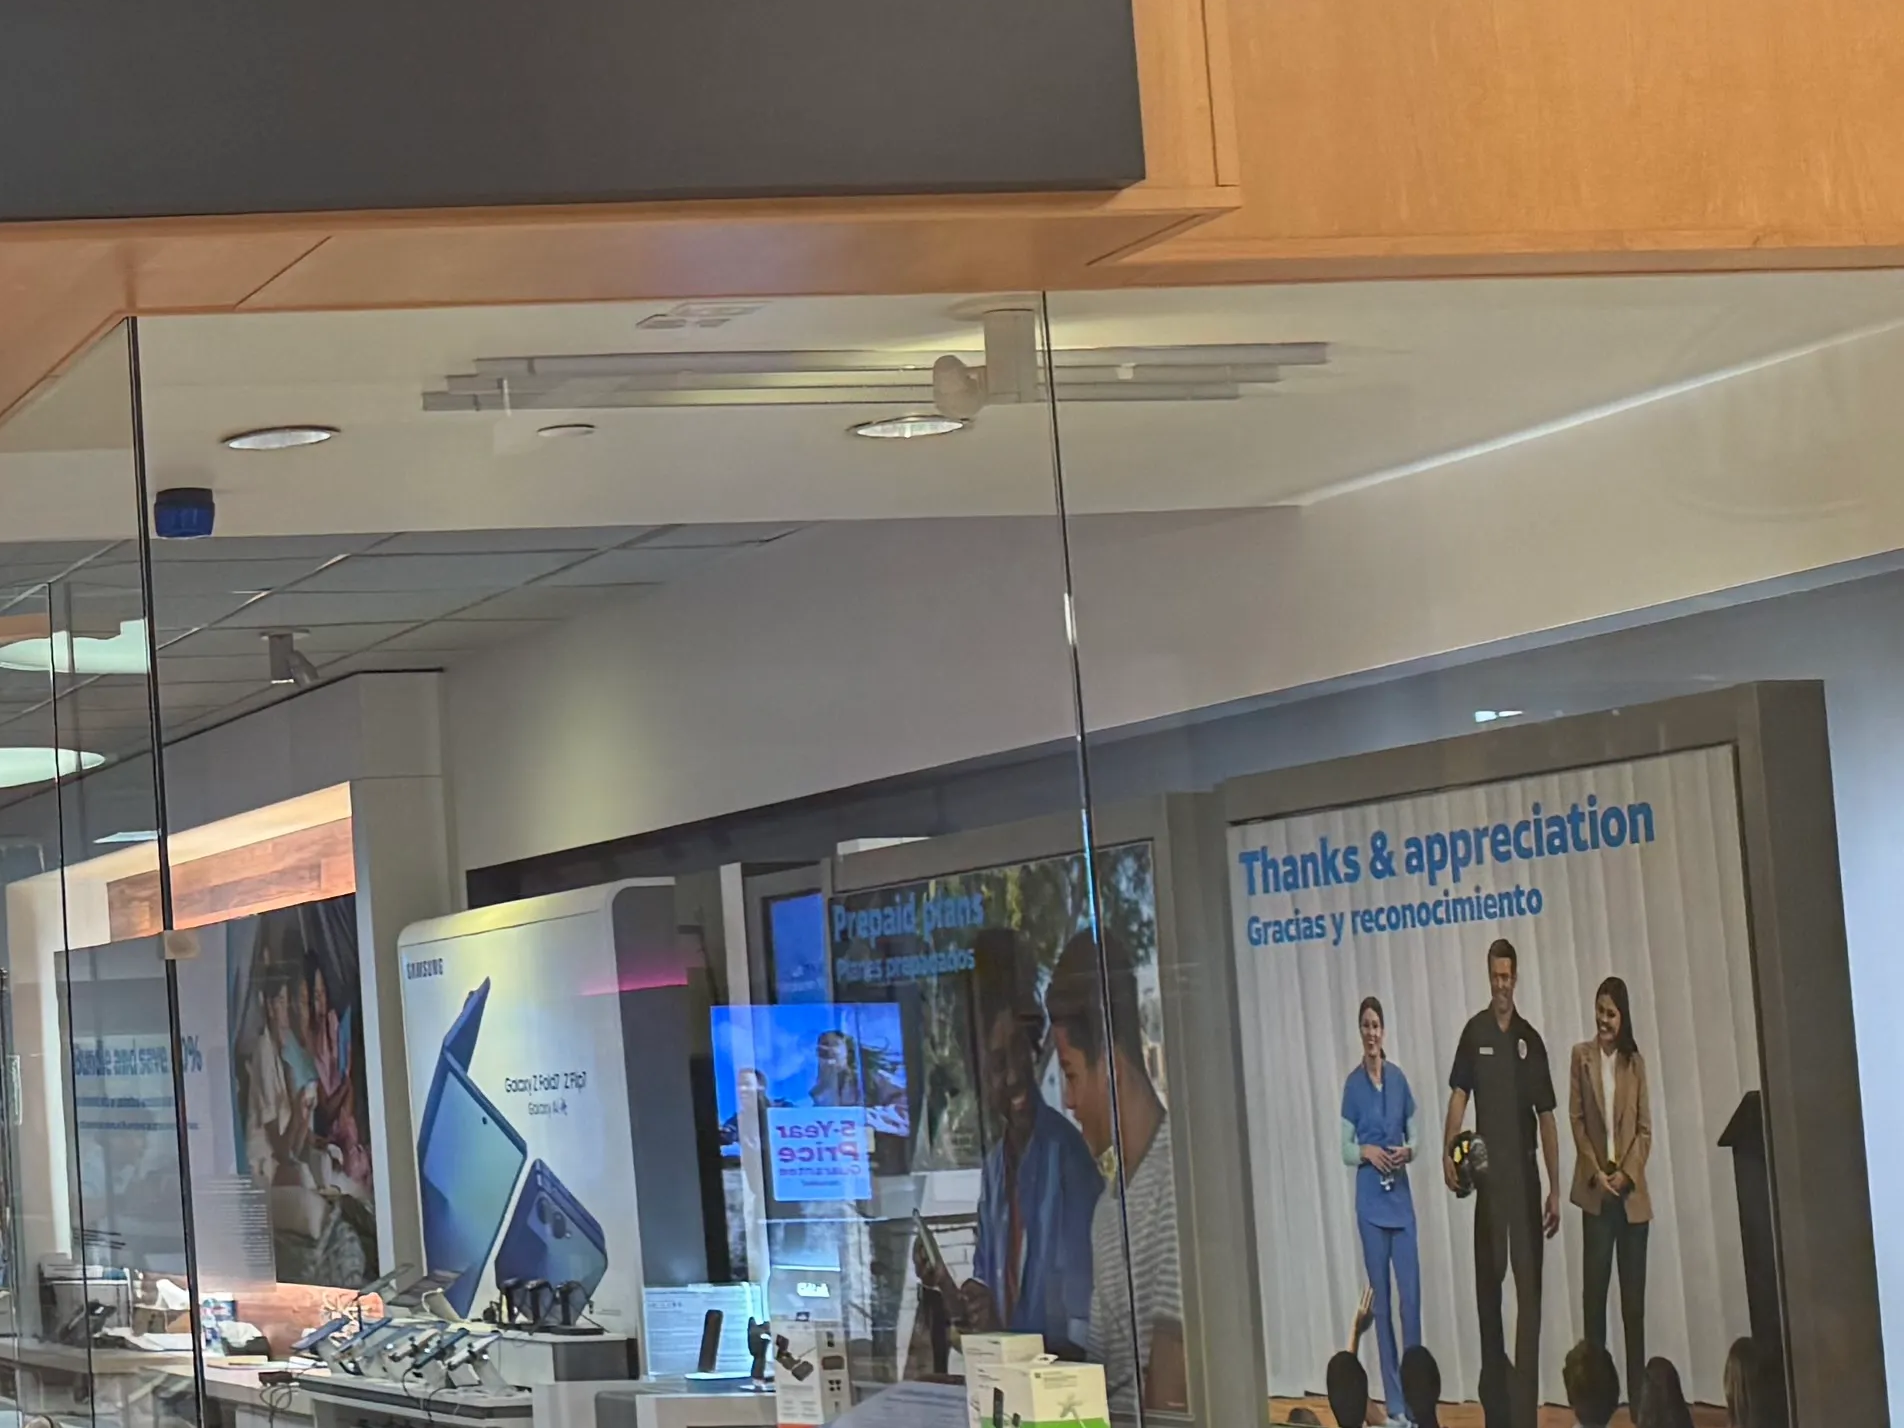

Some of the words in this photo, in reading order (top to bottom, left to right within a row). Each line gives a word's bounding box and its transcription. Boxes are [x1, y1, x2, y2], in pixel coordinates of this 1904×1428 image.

[1239, 836, 1361, 896] Thanks
[1369, 830, 1396, 878] &
[1404, 794, 1655, 886] appreciation
[834, 892, 916, 949] Prepaid
[923, 888, 984, 946] plans
[1247, 908, 1327, 946] Gracias
[1331, 910, 1346, 946] y
[1351, 884, 1543, 936] reconocimiento
[407, 958, 444, 980] SAMSUNG
